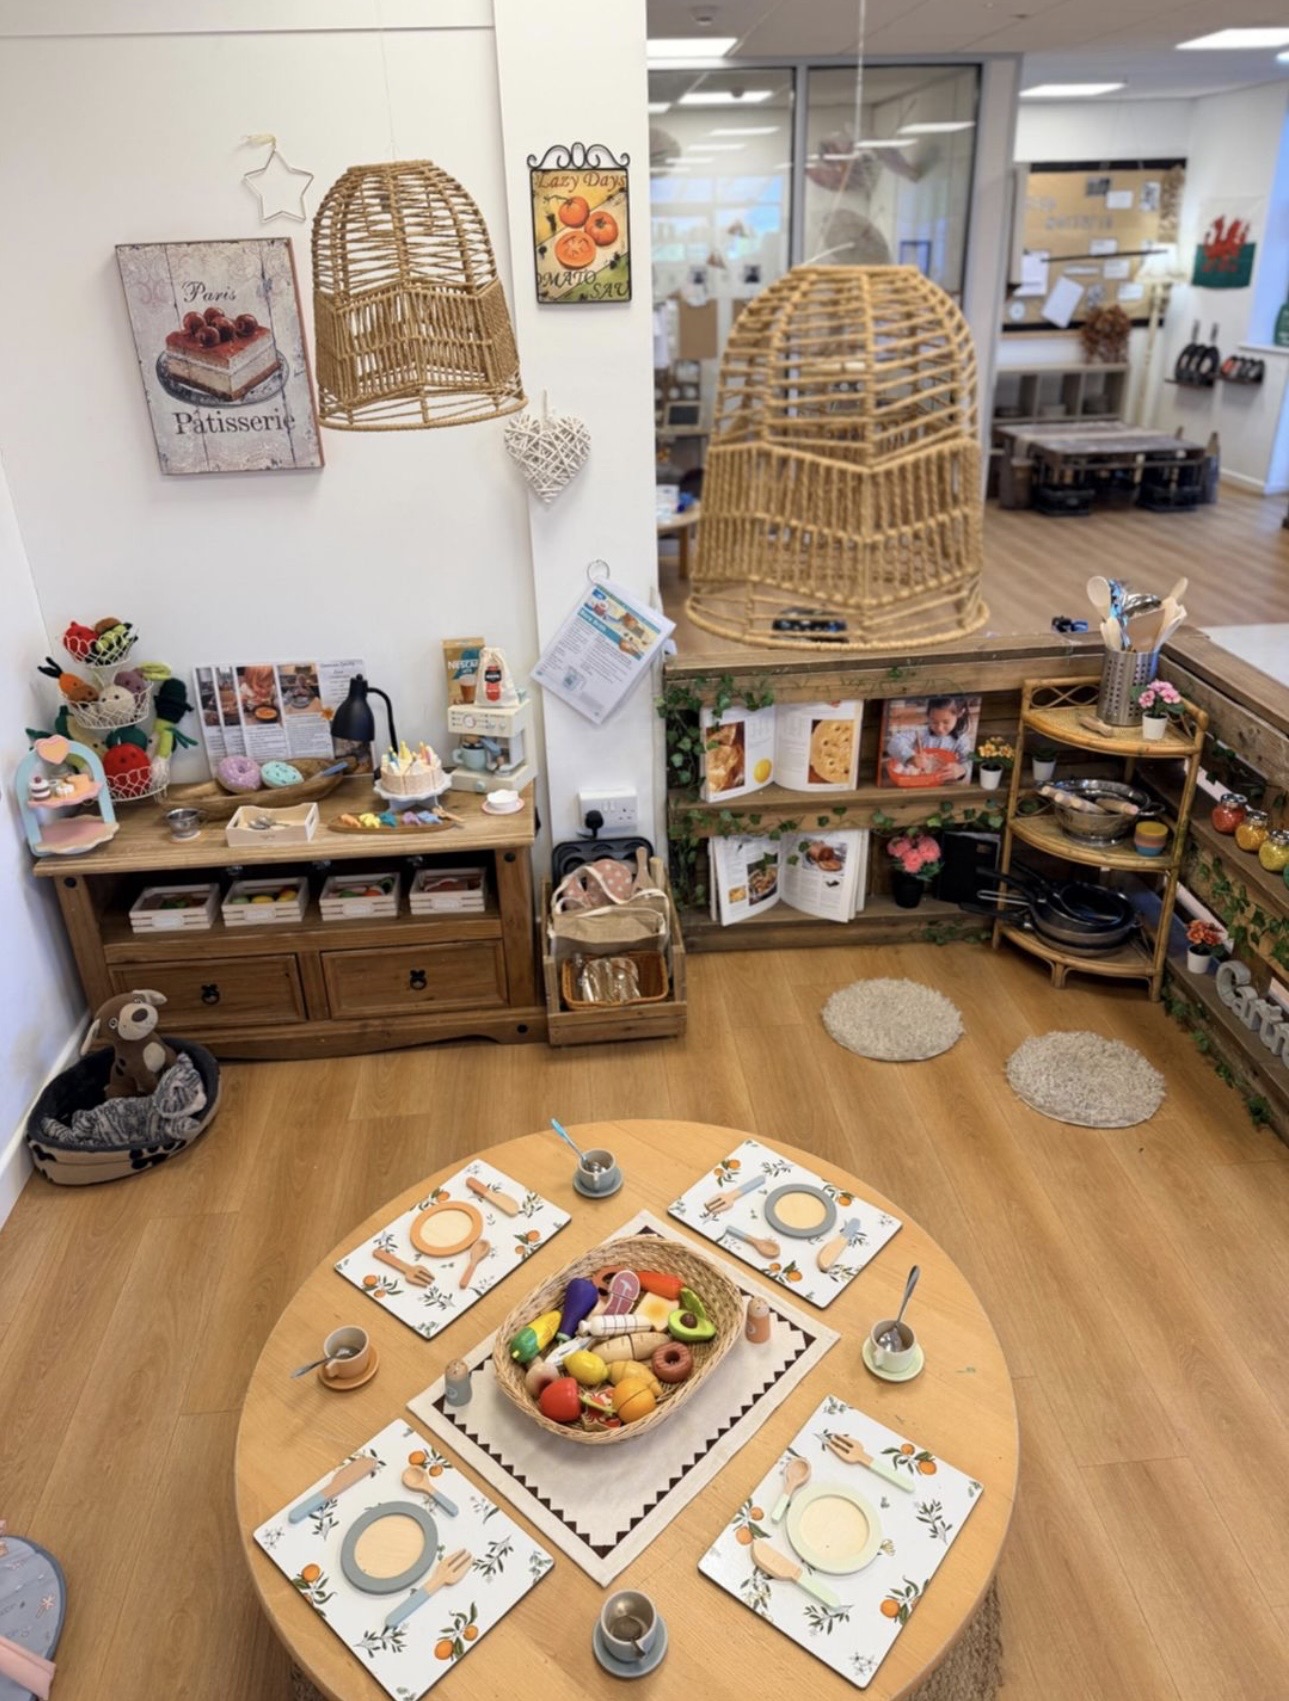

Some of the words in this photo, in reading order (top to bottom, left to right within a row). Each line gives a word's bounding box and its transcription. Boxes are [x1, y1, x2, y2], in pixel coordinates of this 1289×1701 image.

[537, 173, 579, 193] Lazy
[583, 171, 625, 192] Days
[182, 281, 237, 302] Paris
[172, 408, 296, 435] Pâtisserie
